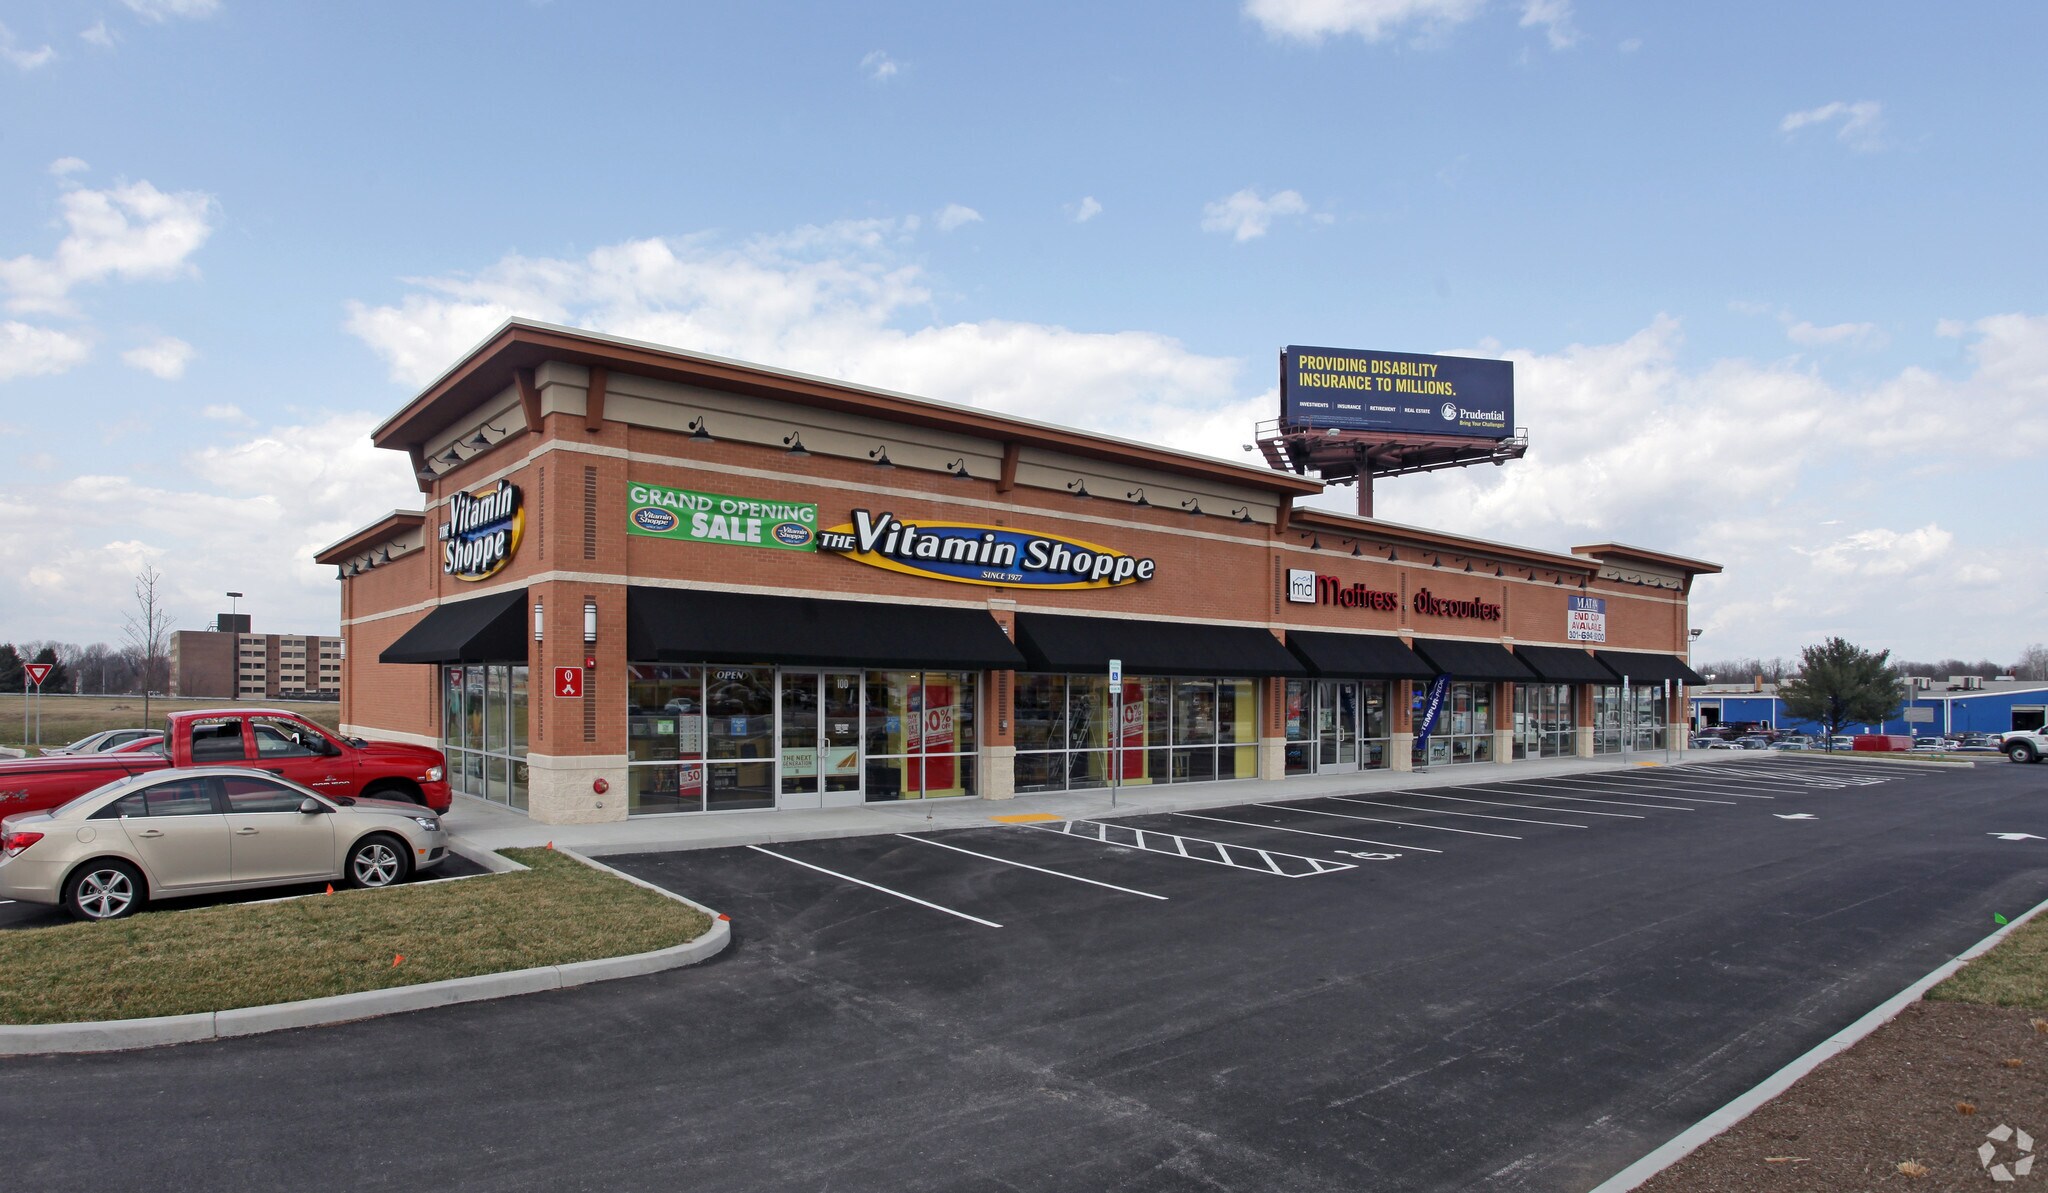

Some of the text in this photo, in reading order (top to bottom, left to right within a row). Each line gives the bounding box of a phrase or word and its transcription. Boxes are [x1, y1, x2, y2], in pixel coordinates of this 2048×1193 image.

[1299, 355, 1438, 378] PROVIDING DISABILITY
[1299, 372, 1457, 396] INSURANCE TO MILLIONS.
[1299, 401, 1329, 409] INVESTMENTS
[1460, 408, 1505, 421] Prudential
[450, 479, 513, 537] Vitamin
[630, 486, 815, 523] GRAND OPENING
[439, 522, 451, 541] THE
[690, 512, 762, 543] SALE
[443, 529, 506, 575] Shoppe
[821, 510, 1155, 583] THE Vitamin Shoppe
[982, 571, 1023, 581] SINCE 1977
[1292, 574, 1313, 597] md
[1415, 588, 1501, 621] discounters
[1574, 612, 1589, 621] END
[716, 671, 744, 680] OPEN
[837, 679, 849, 689] 100
[687, 770, 701, 782] 50
